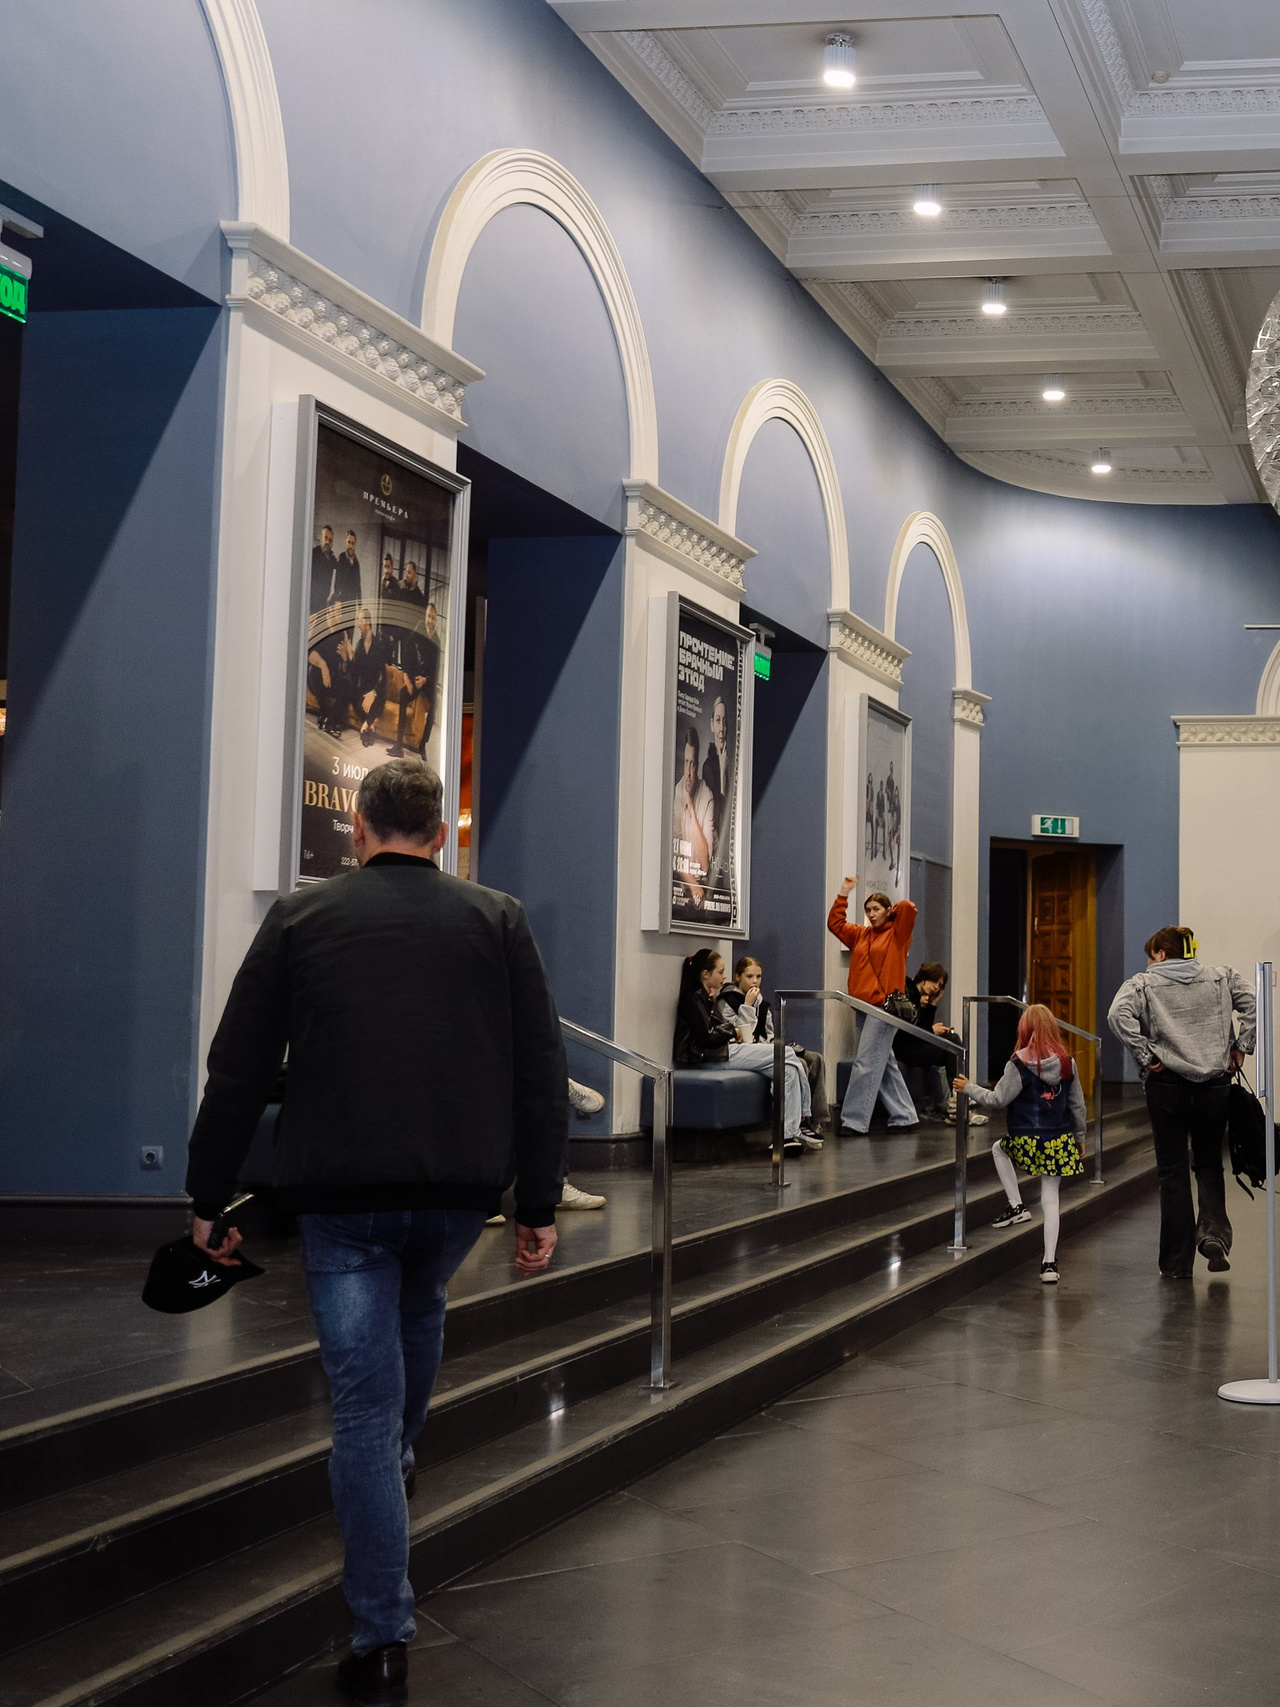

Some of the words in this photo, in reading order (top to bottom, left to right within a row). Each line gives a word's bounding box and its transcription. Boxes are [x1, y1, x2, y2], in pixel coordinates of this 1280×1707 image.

[0, 274, 26, 315] ОД
[363, 491, 409, 519] ПРЕМЬЕРА
[678, 647, 724, 682] БРАЧНЫЙ
[678, 664, 706, 693] ЭТЮД
[331, 756, 341, 776] 3
[343, 763, 371, 781] июл
